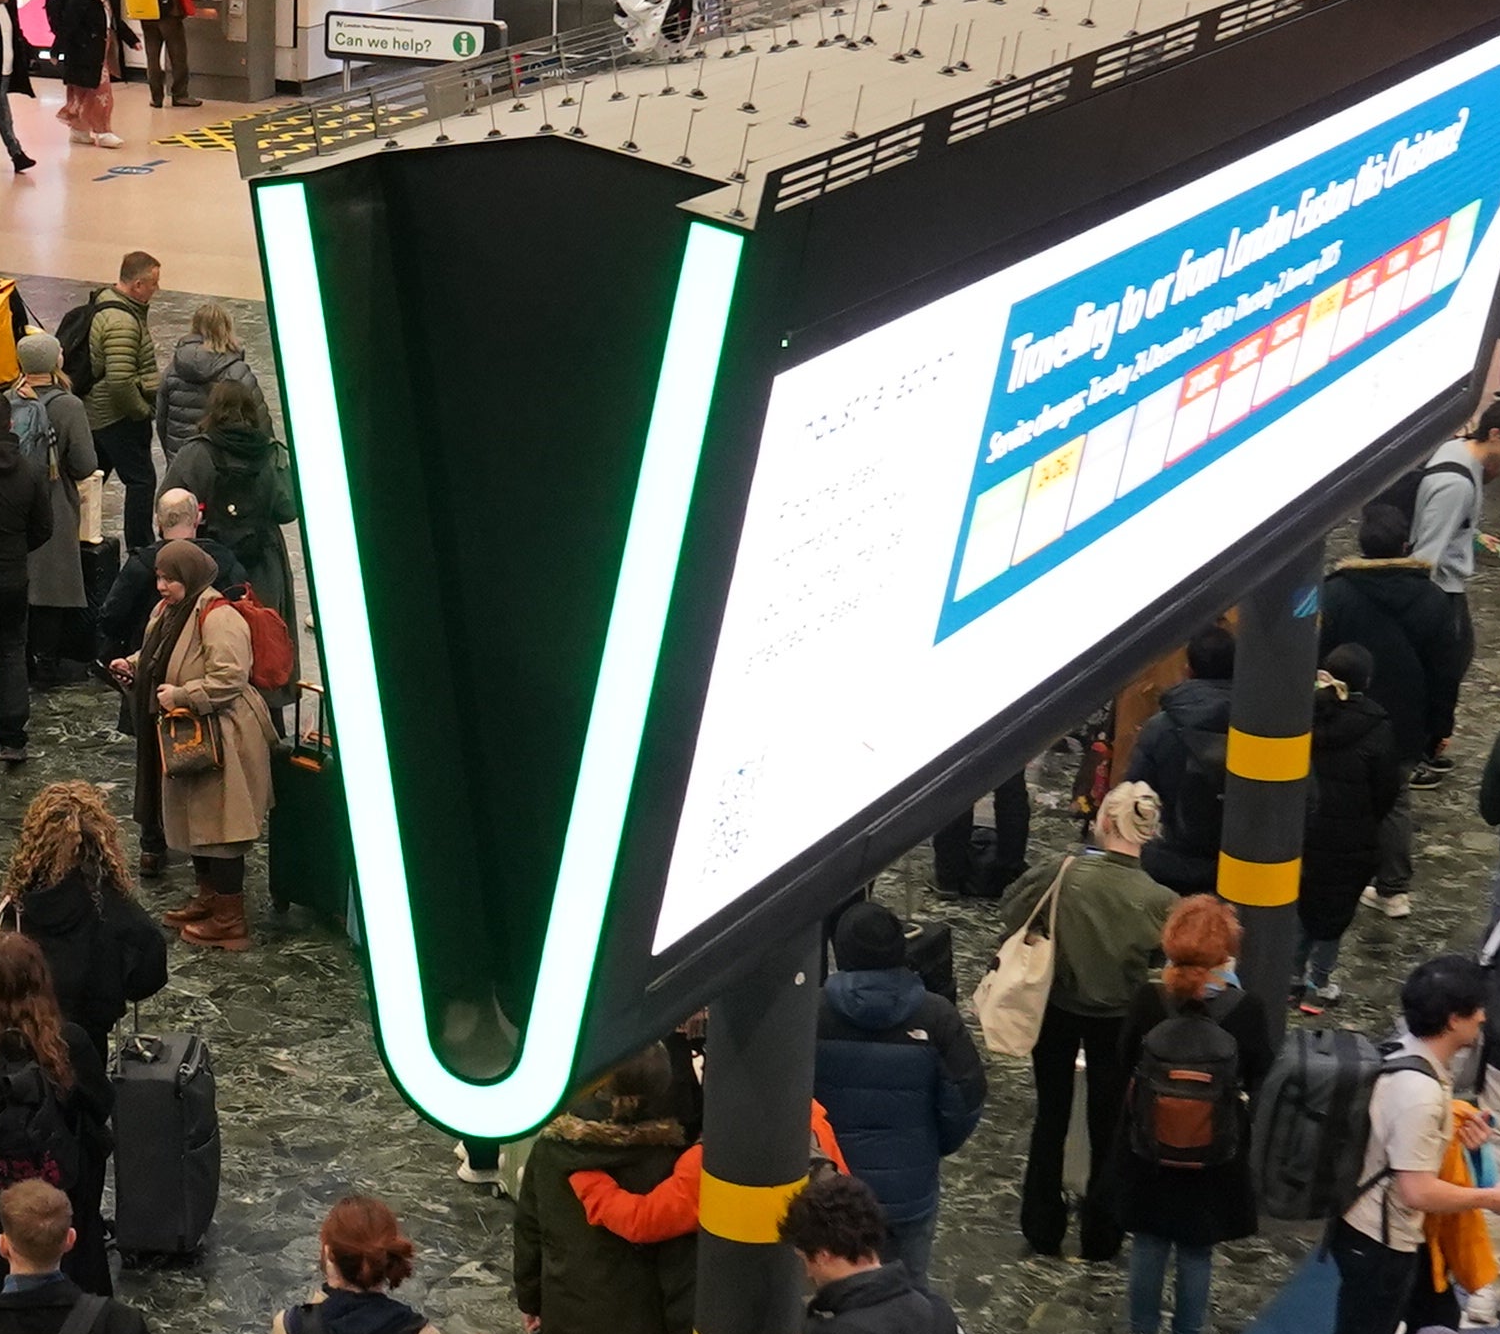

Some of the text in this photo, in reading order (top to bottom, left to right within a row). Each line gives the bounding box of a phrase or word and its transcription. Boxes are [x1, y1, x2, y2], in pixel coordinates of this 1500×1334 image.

[335, 32, 432, 54] Can we help?
